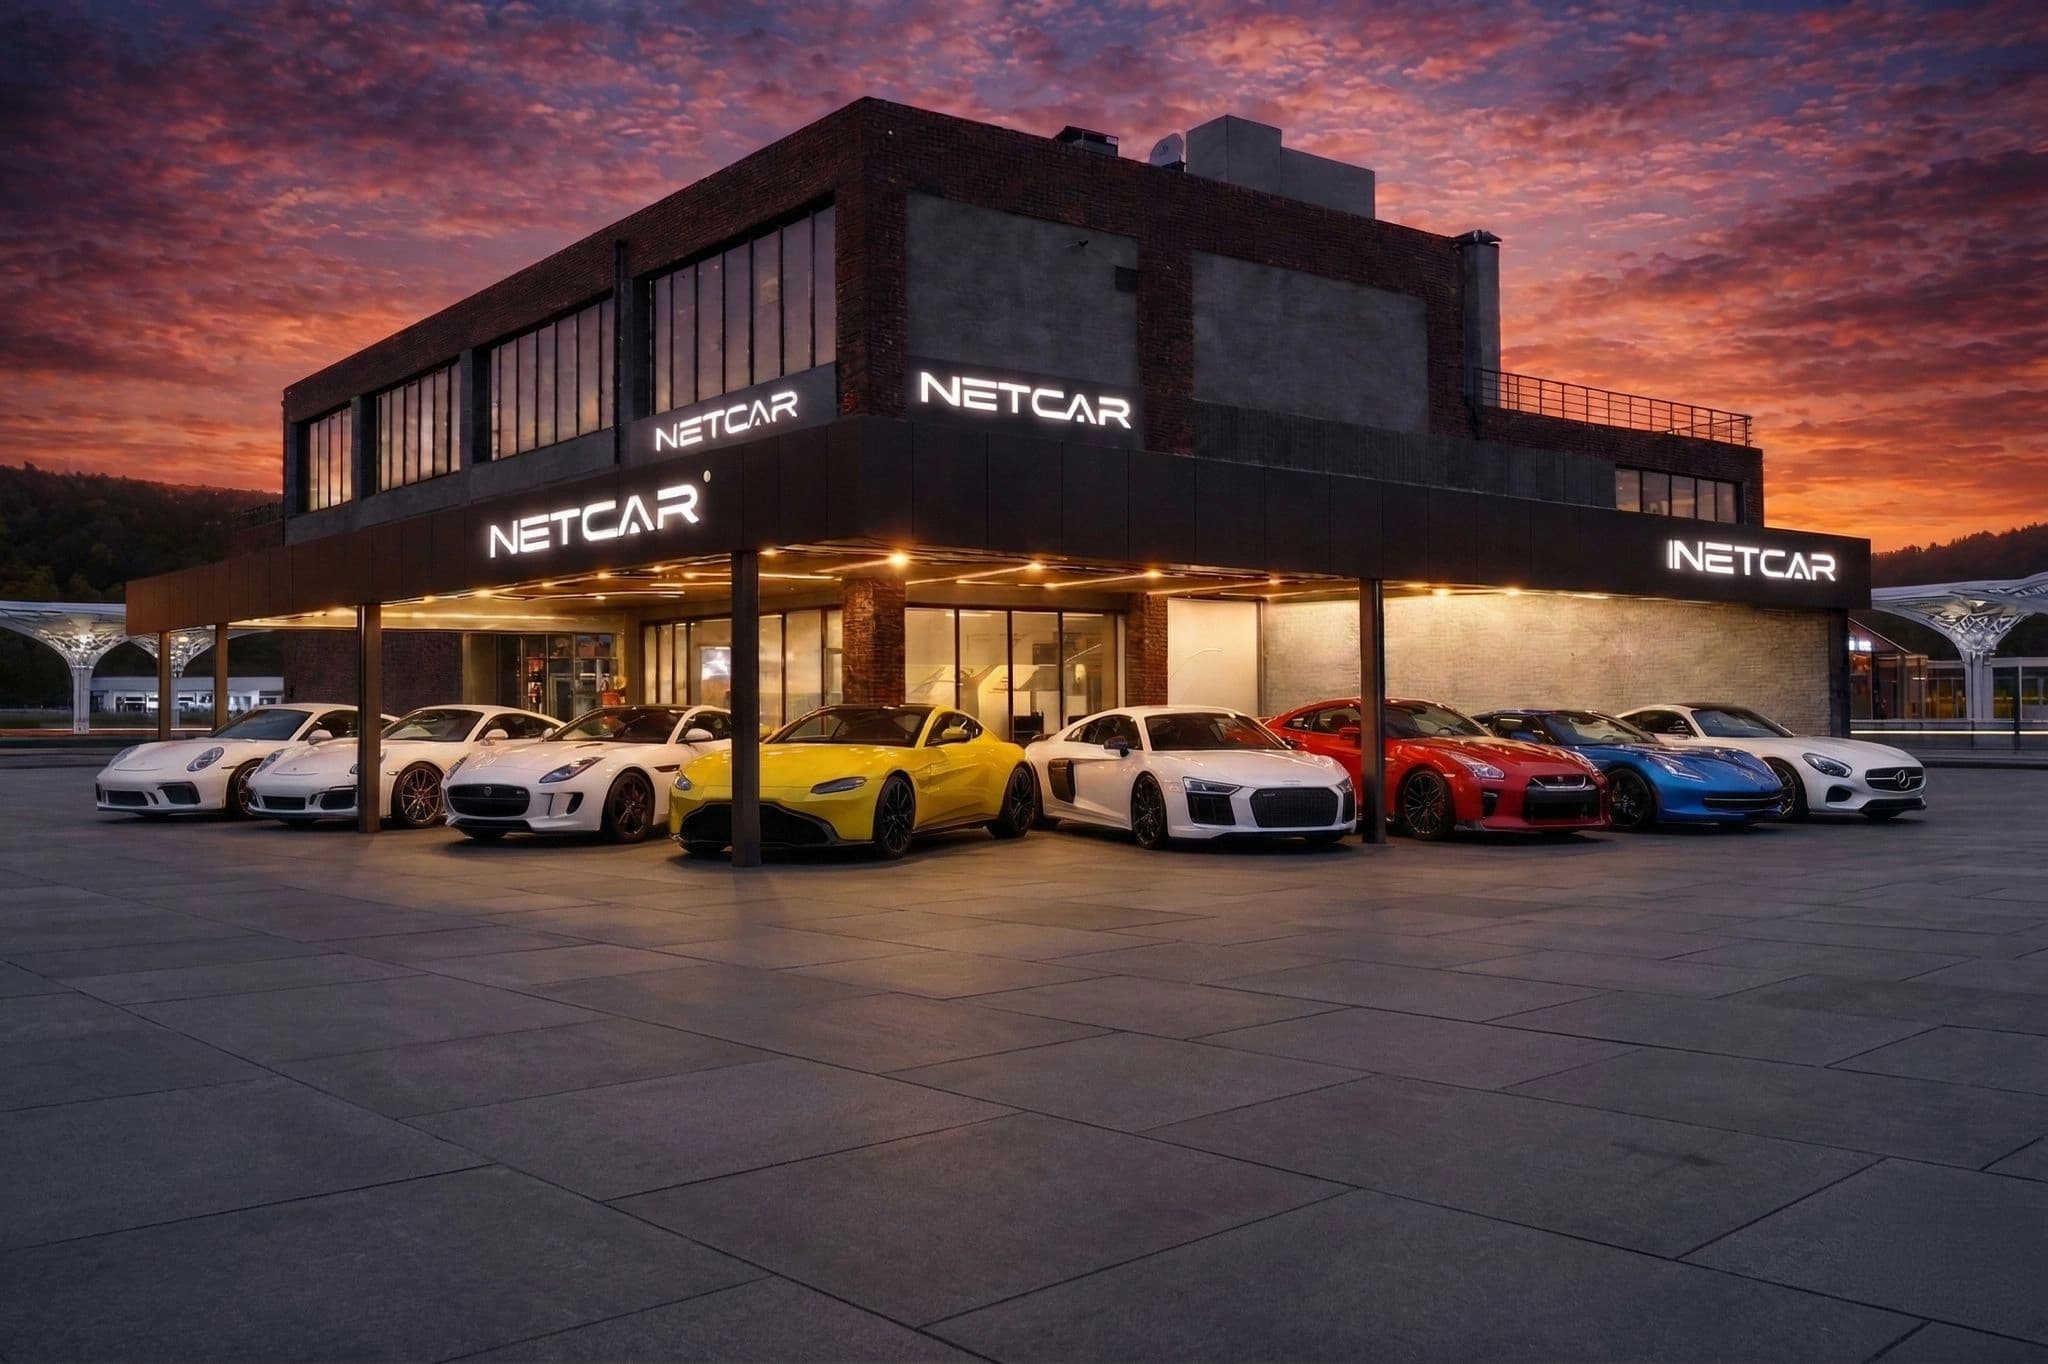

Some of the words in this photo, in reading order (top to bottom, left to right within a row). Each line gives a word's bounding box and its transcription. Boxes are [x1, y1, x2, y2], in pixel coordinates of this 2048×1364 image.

[654, 390, 798, 451] NETCAR
[920, 371, 1131, 429] NETCAR
[489, 484, 700, 558] NETCAR
